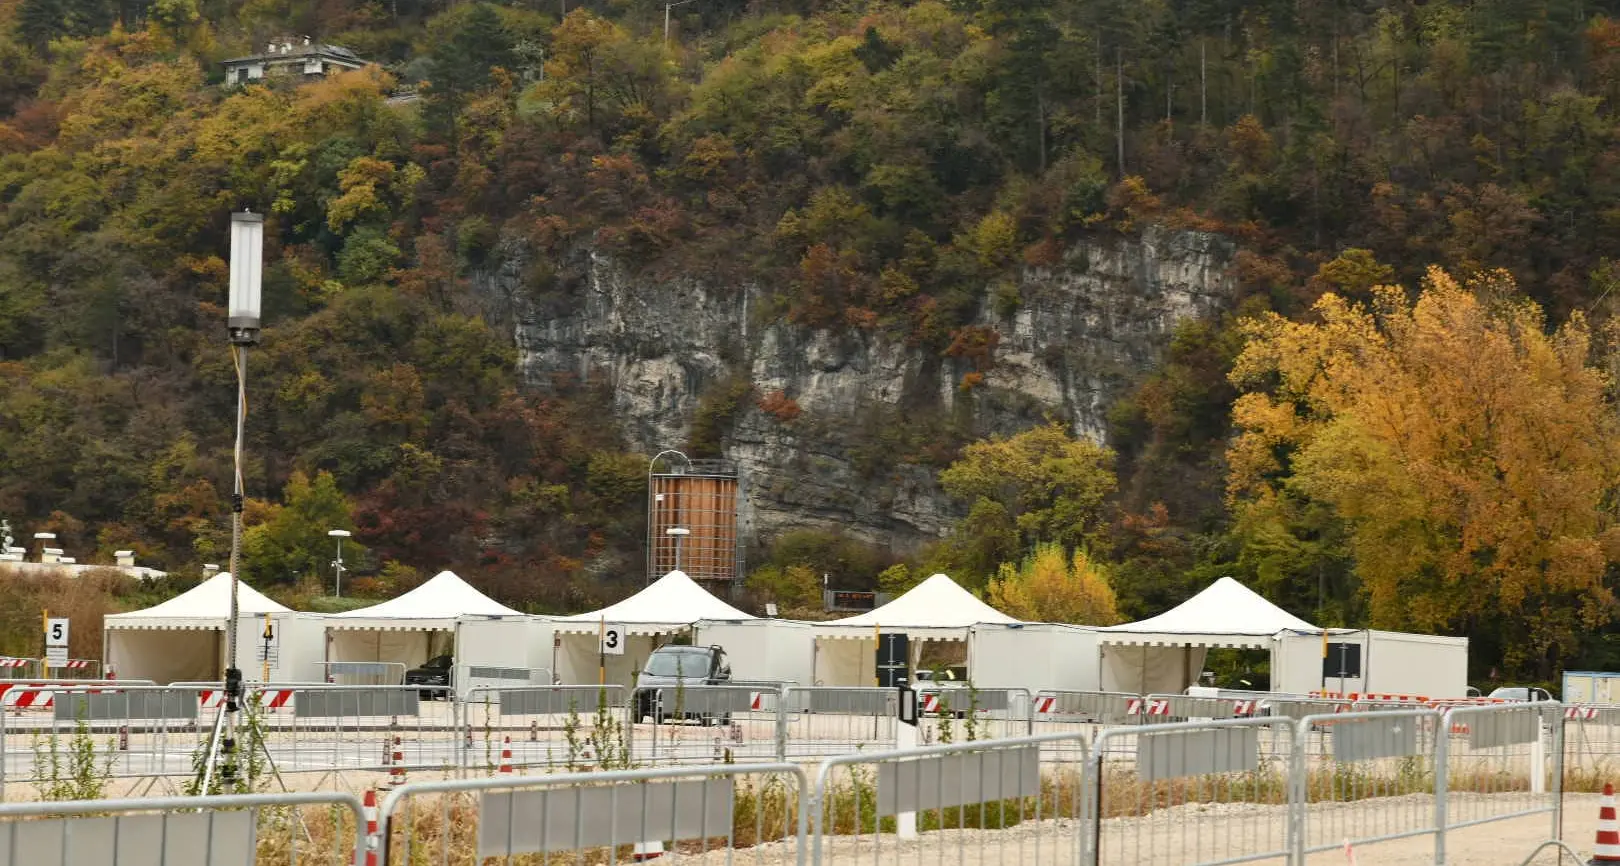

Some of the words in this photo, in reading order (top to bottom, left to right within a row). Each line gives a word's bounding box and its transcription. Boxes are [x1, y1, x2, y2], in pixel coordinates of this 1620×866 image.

[52, 623, 63, 640] 5
[262, 624, 273, 641] 4
[606, 630, 618, 648] 3
